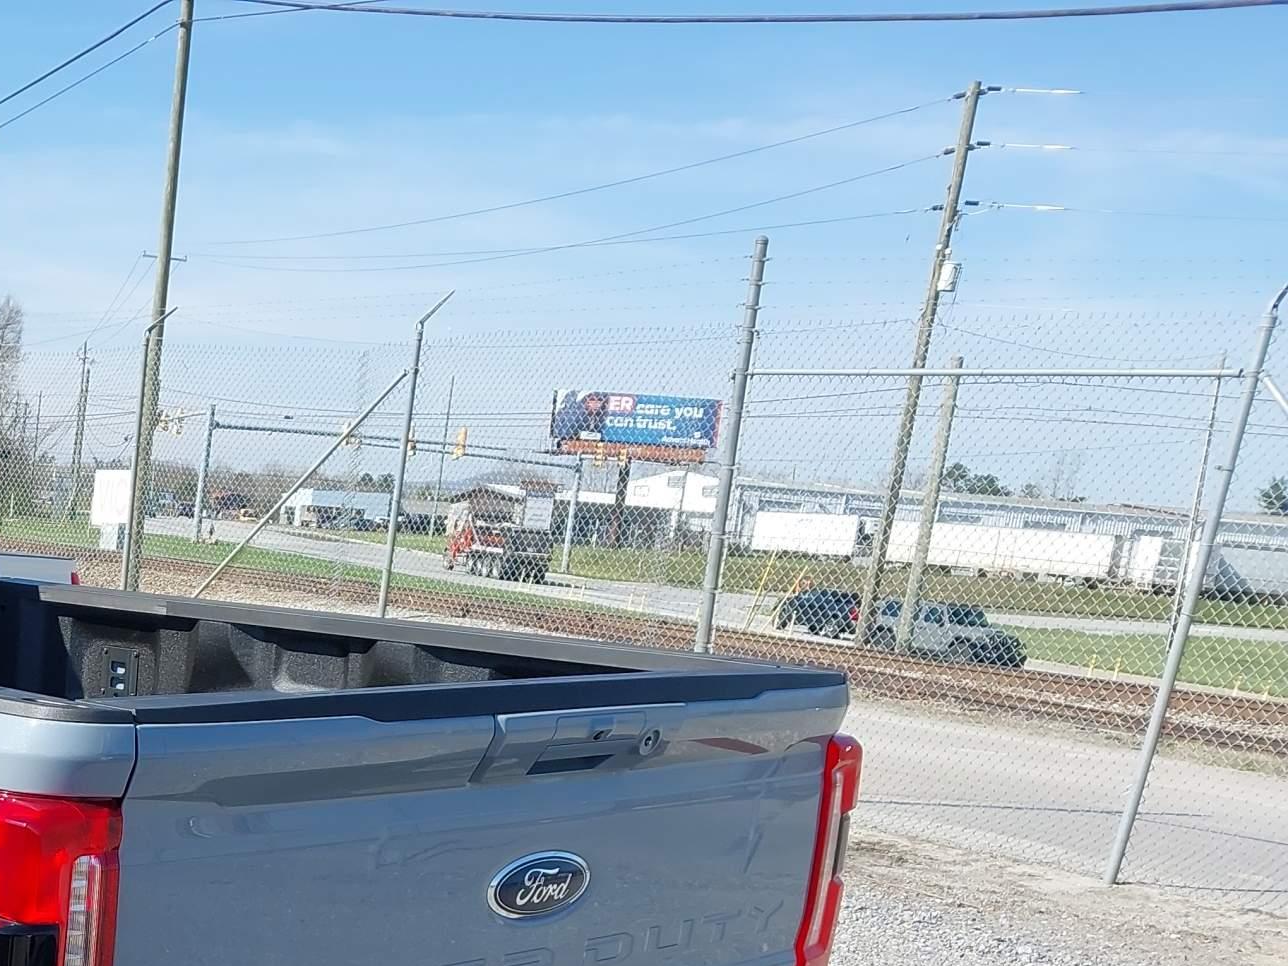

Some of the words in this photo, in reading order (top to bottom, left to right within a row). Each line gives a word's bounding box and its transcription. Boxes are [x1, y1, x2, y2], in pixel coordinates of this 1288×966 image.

[608, 396, 633, 412] ER
[635, 403, 670, 416] care
[674, 406, 704, 419] you
[606, 416, 633, 427] can
[516, 867, 572, 905] Ford
